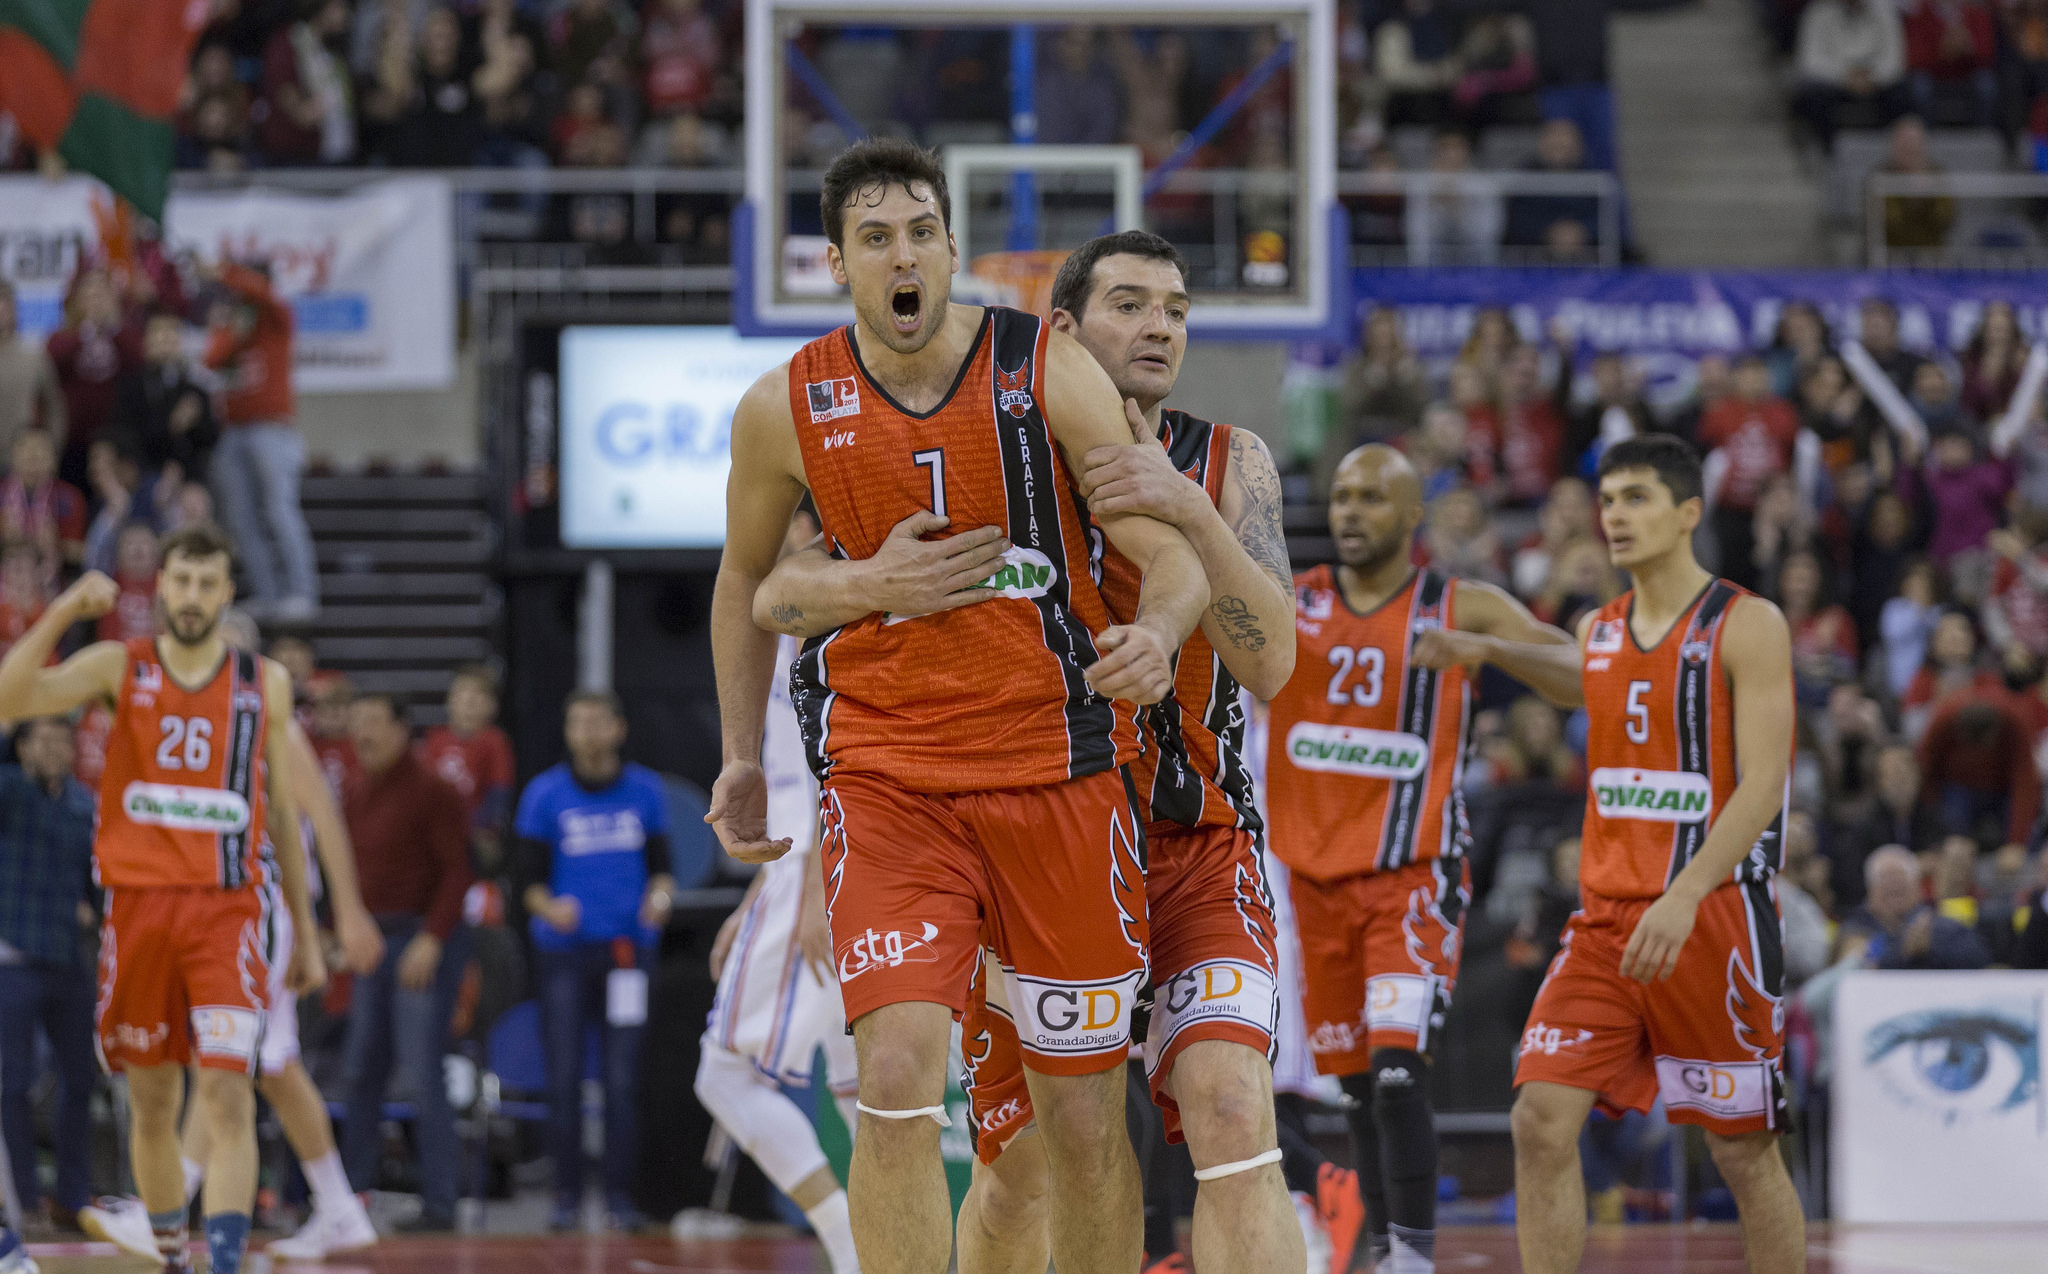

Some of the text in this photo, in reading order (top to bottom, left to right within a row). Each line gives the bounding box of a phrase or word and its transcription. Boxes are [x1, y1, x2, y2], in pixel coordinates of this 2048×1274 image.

[824, 429, 855, 451] vive
[914, 450, 944, 516] 7
[1018, 427, 1039, 547] GRACIAS
[1327, 645, 1385, 707] 23
[1625, 679, 1652, 744] 5
[156, 714, 213, 772] 26
[853, 928, 904, 968] stg
[1037, 989, 1121, 1032] GD
[1166, 966, 1243, 1015] GD
[1036, 1031, 1120, 1046] GranadaDigital
[1681, 1065, 1735, 1101] GD
